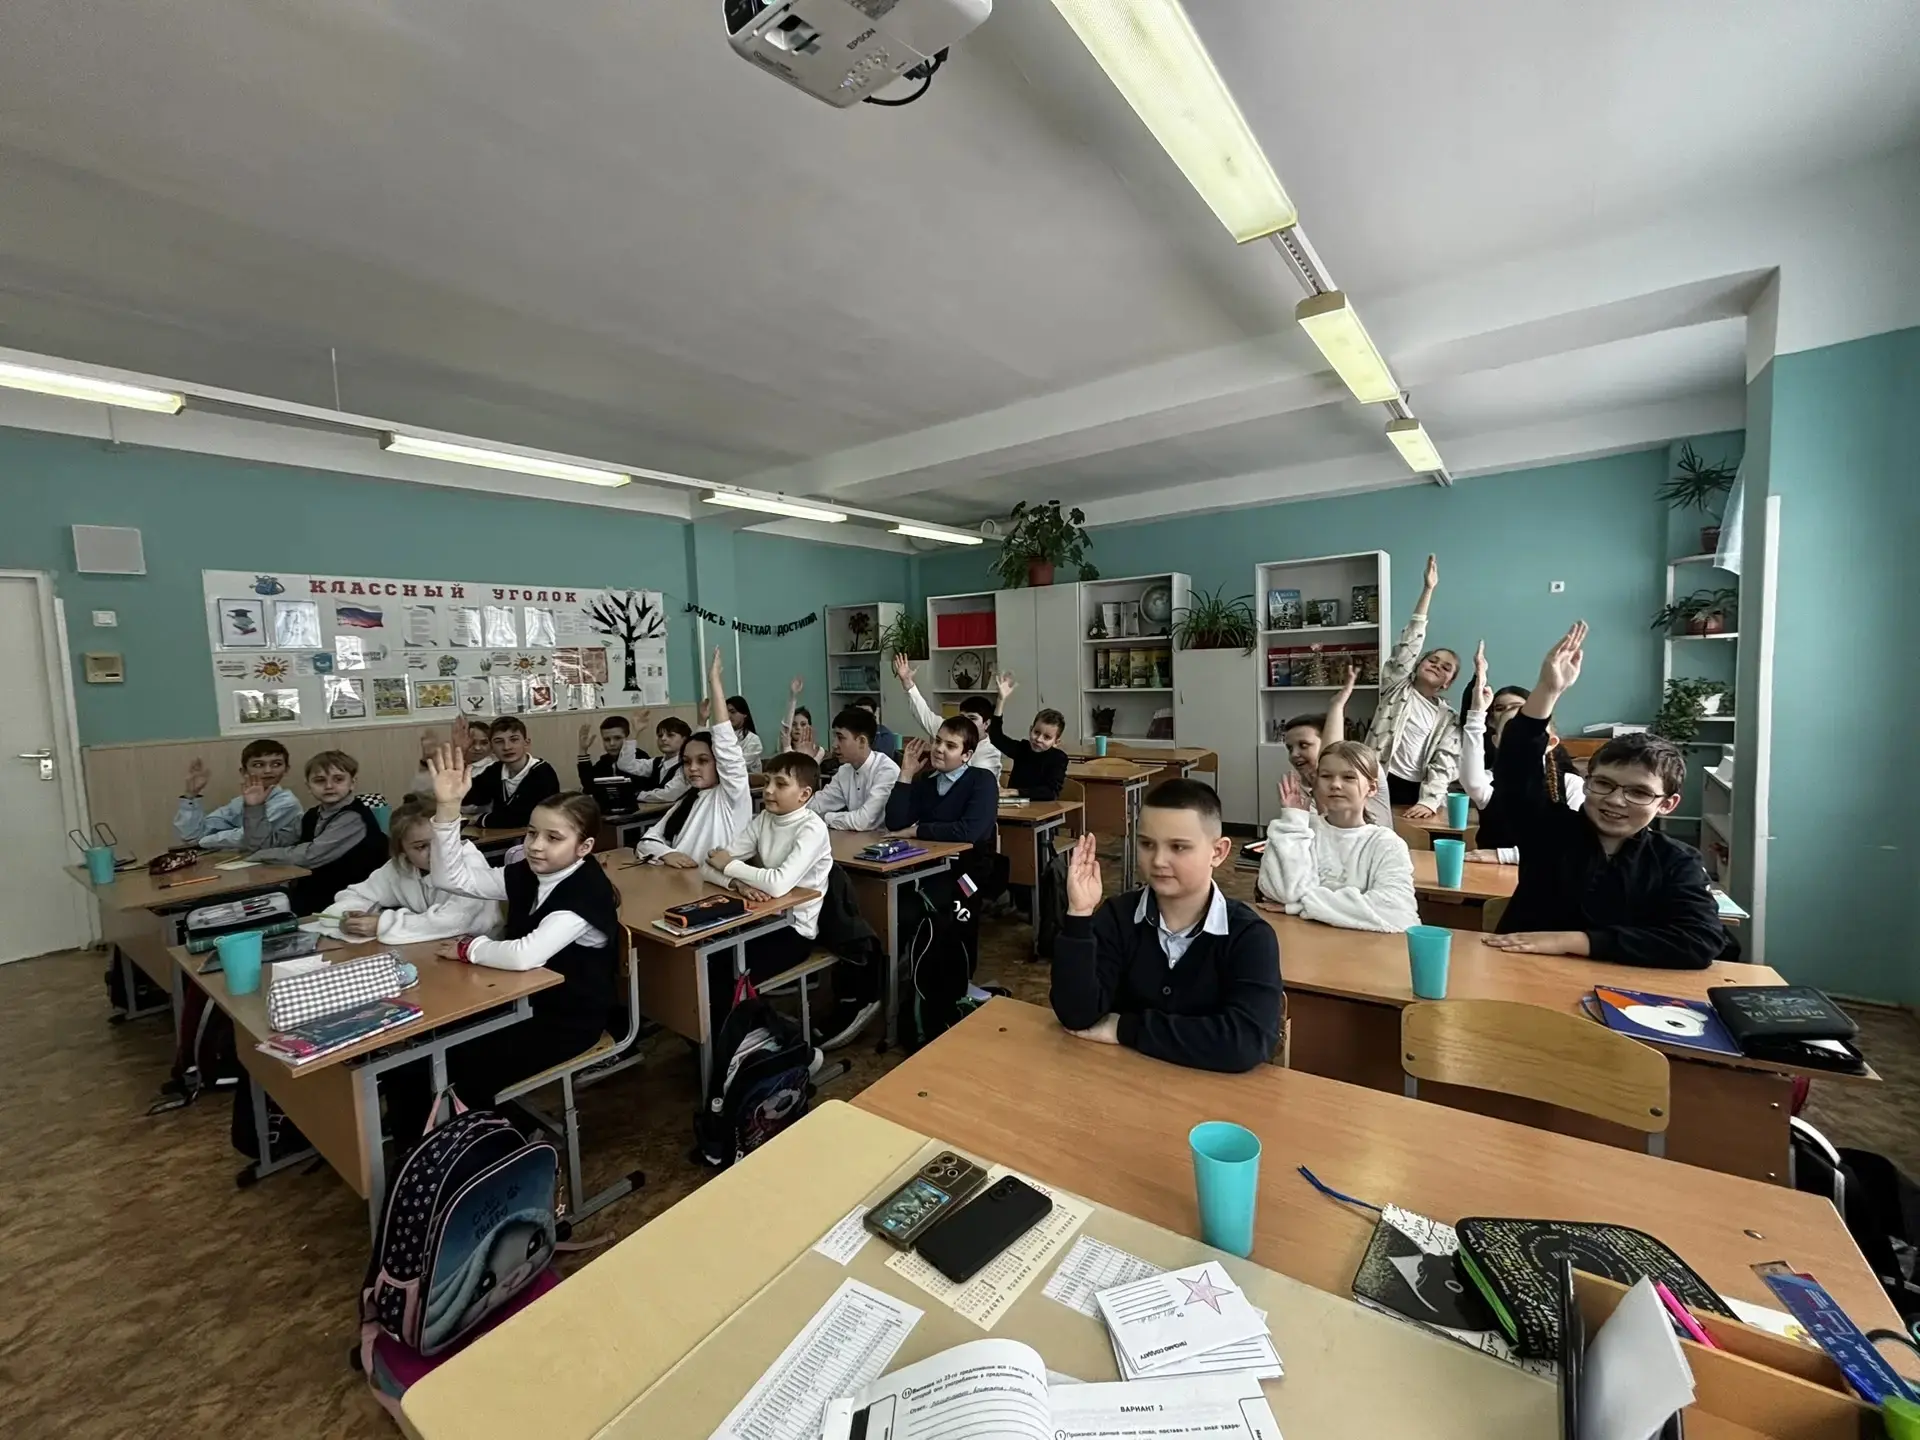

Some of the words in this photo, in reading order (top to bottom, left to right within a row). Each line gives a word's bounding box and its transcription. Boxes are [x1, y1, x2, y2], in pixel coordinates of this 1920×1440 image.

[846, 28, 876, 50] EPSON
[309, 579, 465, 599] КЛАССНЫЙ
[492, 588, 577, 603] УГОЛОК
[685, 602, 726, 627] УЧИСЬ
[731, 620, 772, 636] МЕЧТАЙ
[1139, 1347, 1164, 1360] СОЛДАТУ
[1164, 1341, 1187, 1353] ПИСЬМО
[1120, 1405, 1154, 1413] ВАРИАНТ
